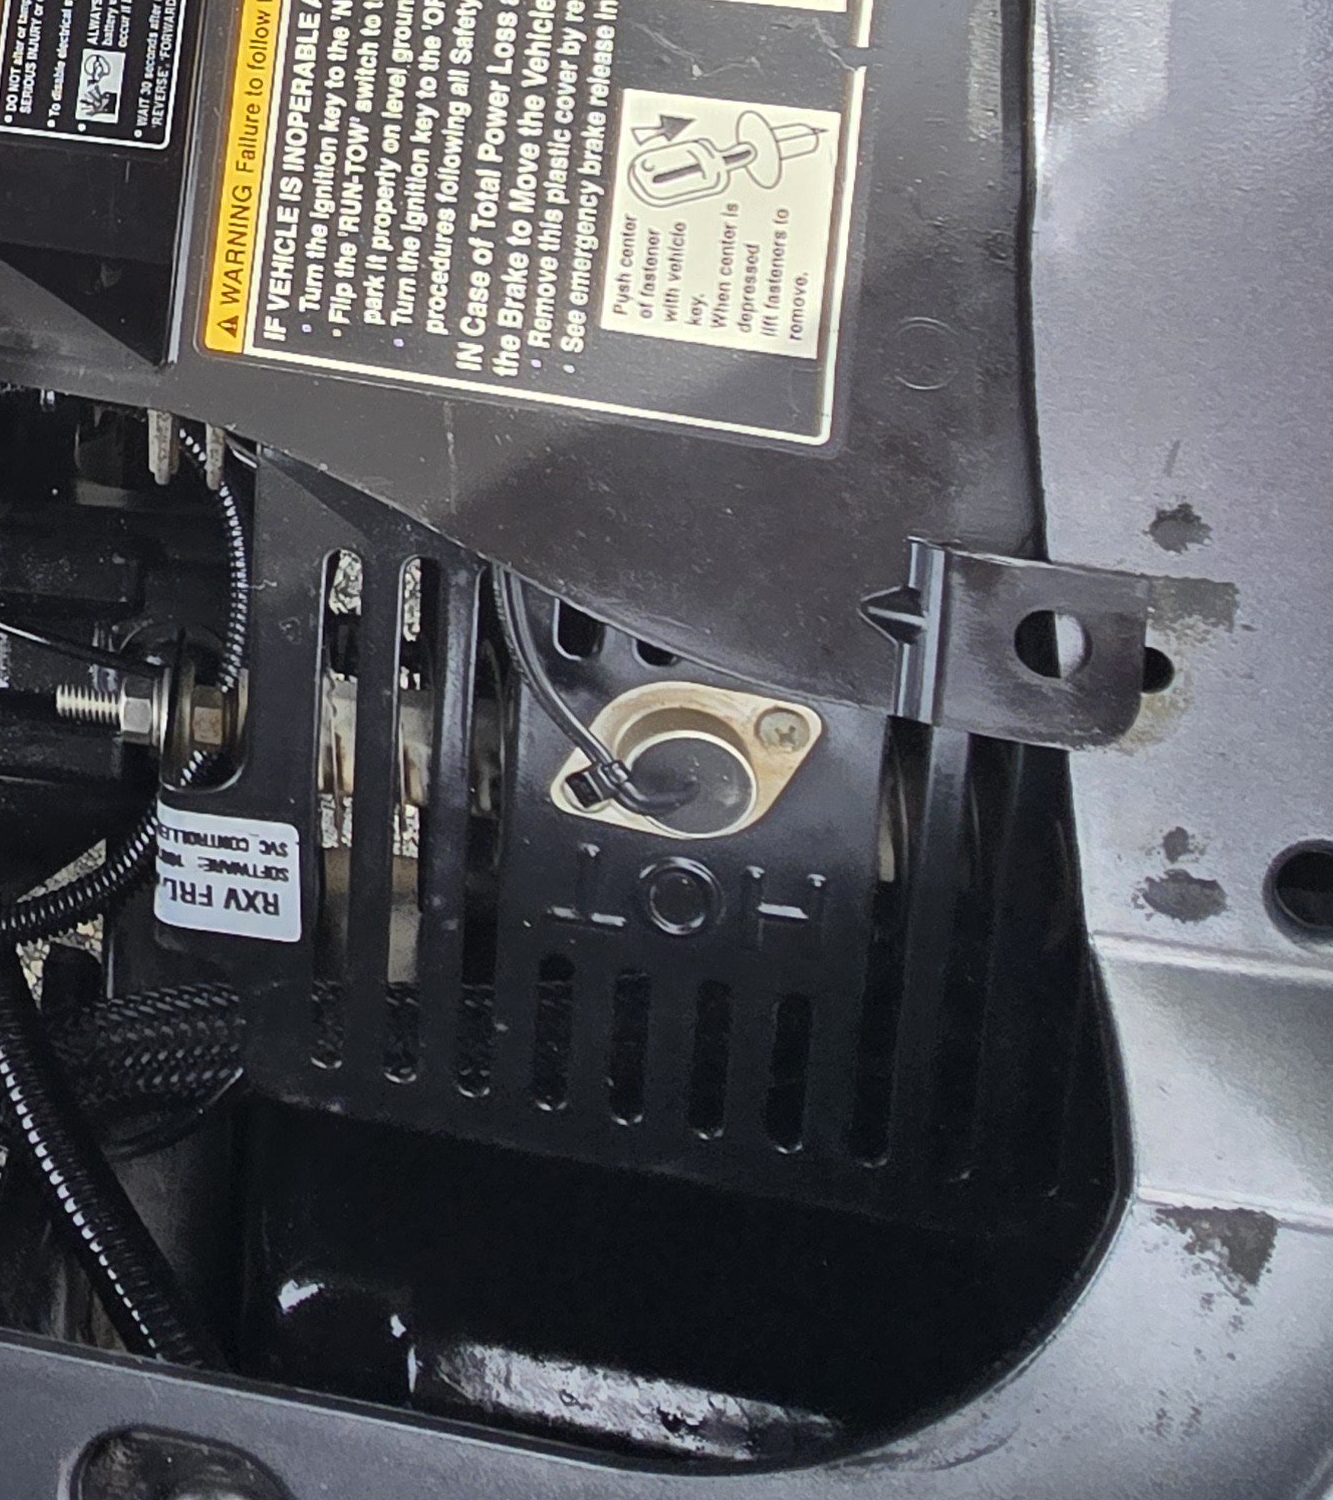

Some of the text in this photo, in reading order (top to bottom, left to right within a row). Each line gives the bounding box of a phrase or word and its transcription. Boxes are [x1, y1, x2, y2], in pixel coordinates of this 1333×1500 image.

[101, 7, 119, 46] battery
[246, 10, 271, 70] follow
[327, 26, 350, 61] the
[359, 14, 382, 36] to
[487, 11, 518, 74] Loss
[556, 27, 587, 56] by
[244, 78, 264, 96] to
[282, 12, 321, 172] INOPERABLE
[324, 66, 346, 89] to
[353, 41, 379, 113] switch
[552, 59, 578, 124] cover
[586, 25, 615, 107] release
[235, 103, 261, 173] Failure
[318, 92, 347, 132] key
[477, 79, 511, 163] Power
[516, 94, 546, 137] the
[542, 128, 575, 204] plastic
[577, 111, 606, 176] brake
[278, 176, 303, 201] IS
[308, 136, 338, 219] ignition
[470, 168, 502, 232] Total
[508, 142, 540, 213] Move
[220, 185, 252, 305] WARNING
[266, 205, 300, 311] VEHICLE
[304, 223, 328, 259] the
[333, 241, 358, 278] the
[468, 237, 495, 266] of
[505, 219, 533, 247] to
[537, 209, 565, 252] this
[566, 180, 605, 306] emergency
[621, 216, 636, 267] center
[298, 263, 325, 313] Turn
[496, 251, 530, 329] Brake
[639, 229, 659, 319] of fastener
[665, 222, 686, 321] with vehicle
[712, 203, 738, 328] When center is
[737, 244, 759, 333] depressed
[762, 209, 789, 336] lift fasteners to
[263, 315, 287, 341] IF
[328, 282, 357, 324] Flip
[459, 270, 491, 337] Case
[526, 256, 563, 352] Remove
[559, 309, 589, 353] See
[688, 295, 707, 325] key.
[789, 273, 808, 341] remove.
[455, 341, 484, 371] IN
[492, 334, 521, 377] the
[259, 840, 289, 857] SVC
[223, 886, 280, 916] RXV
